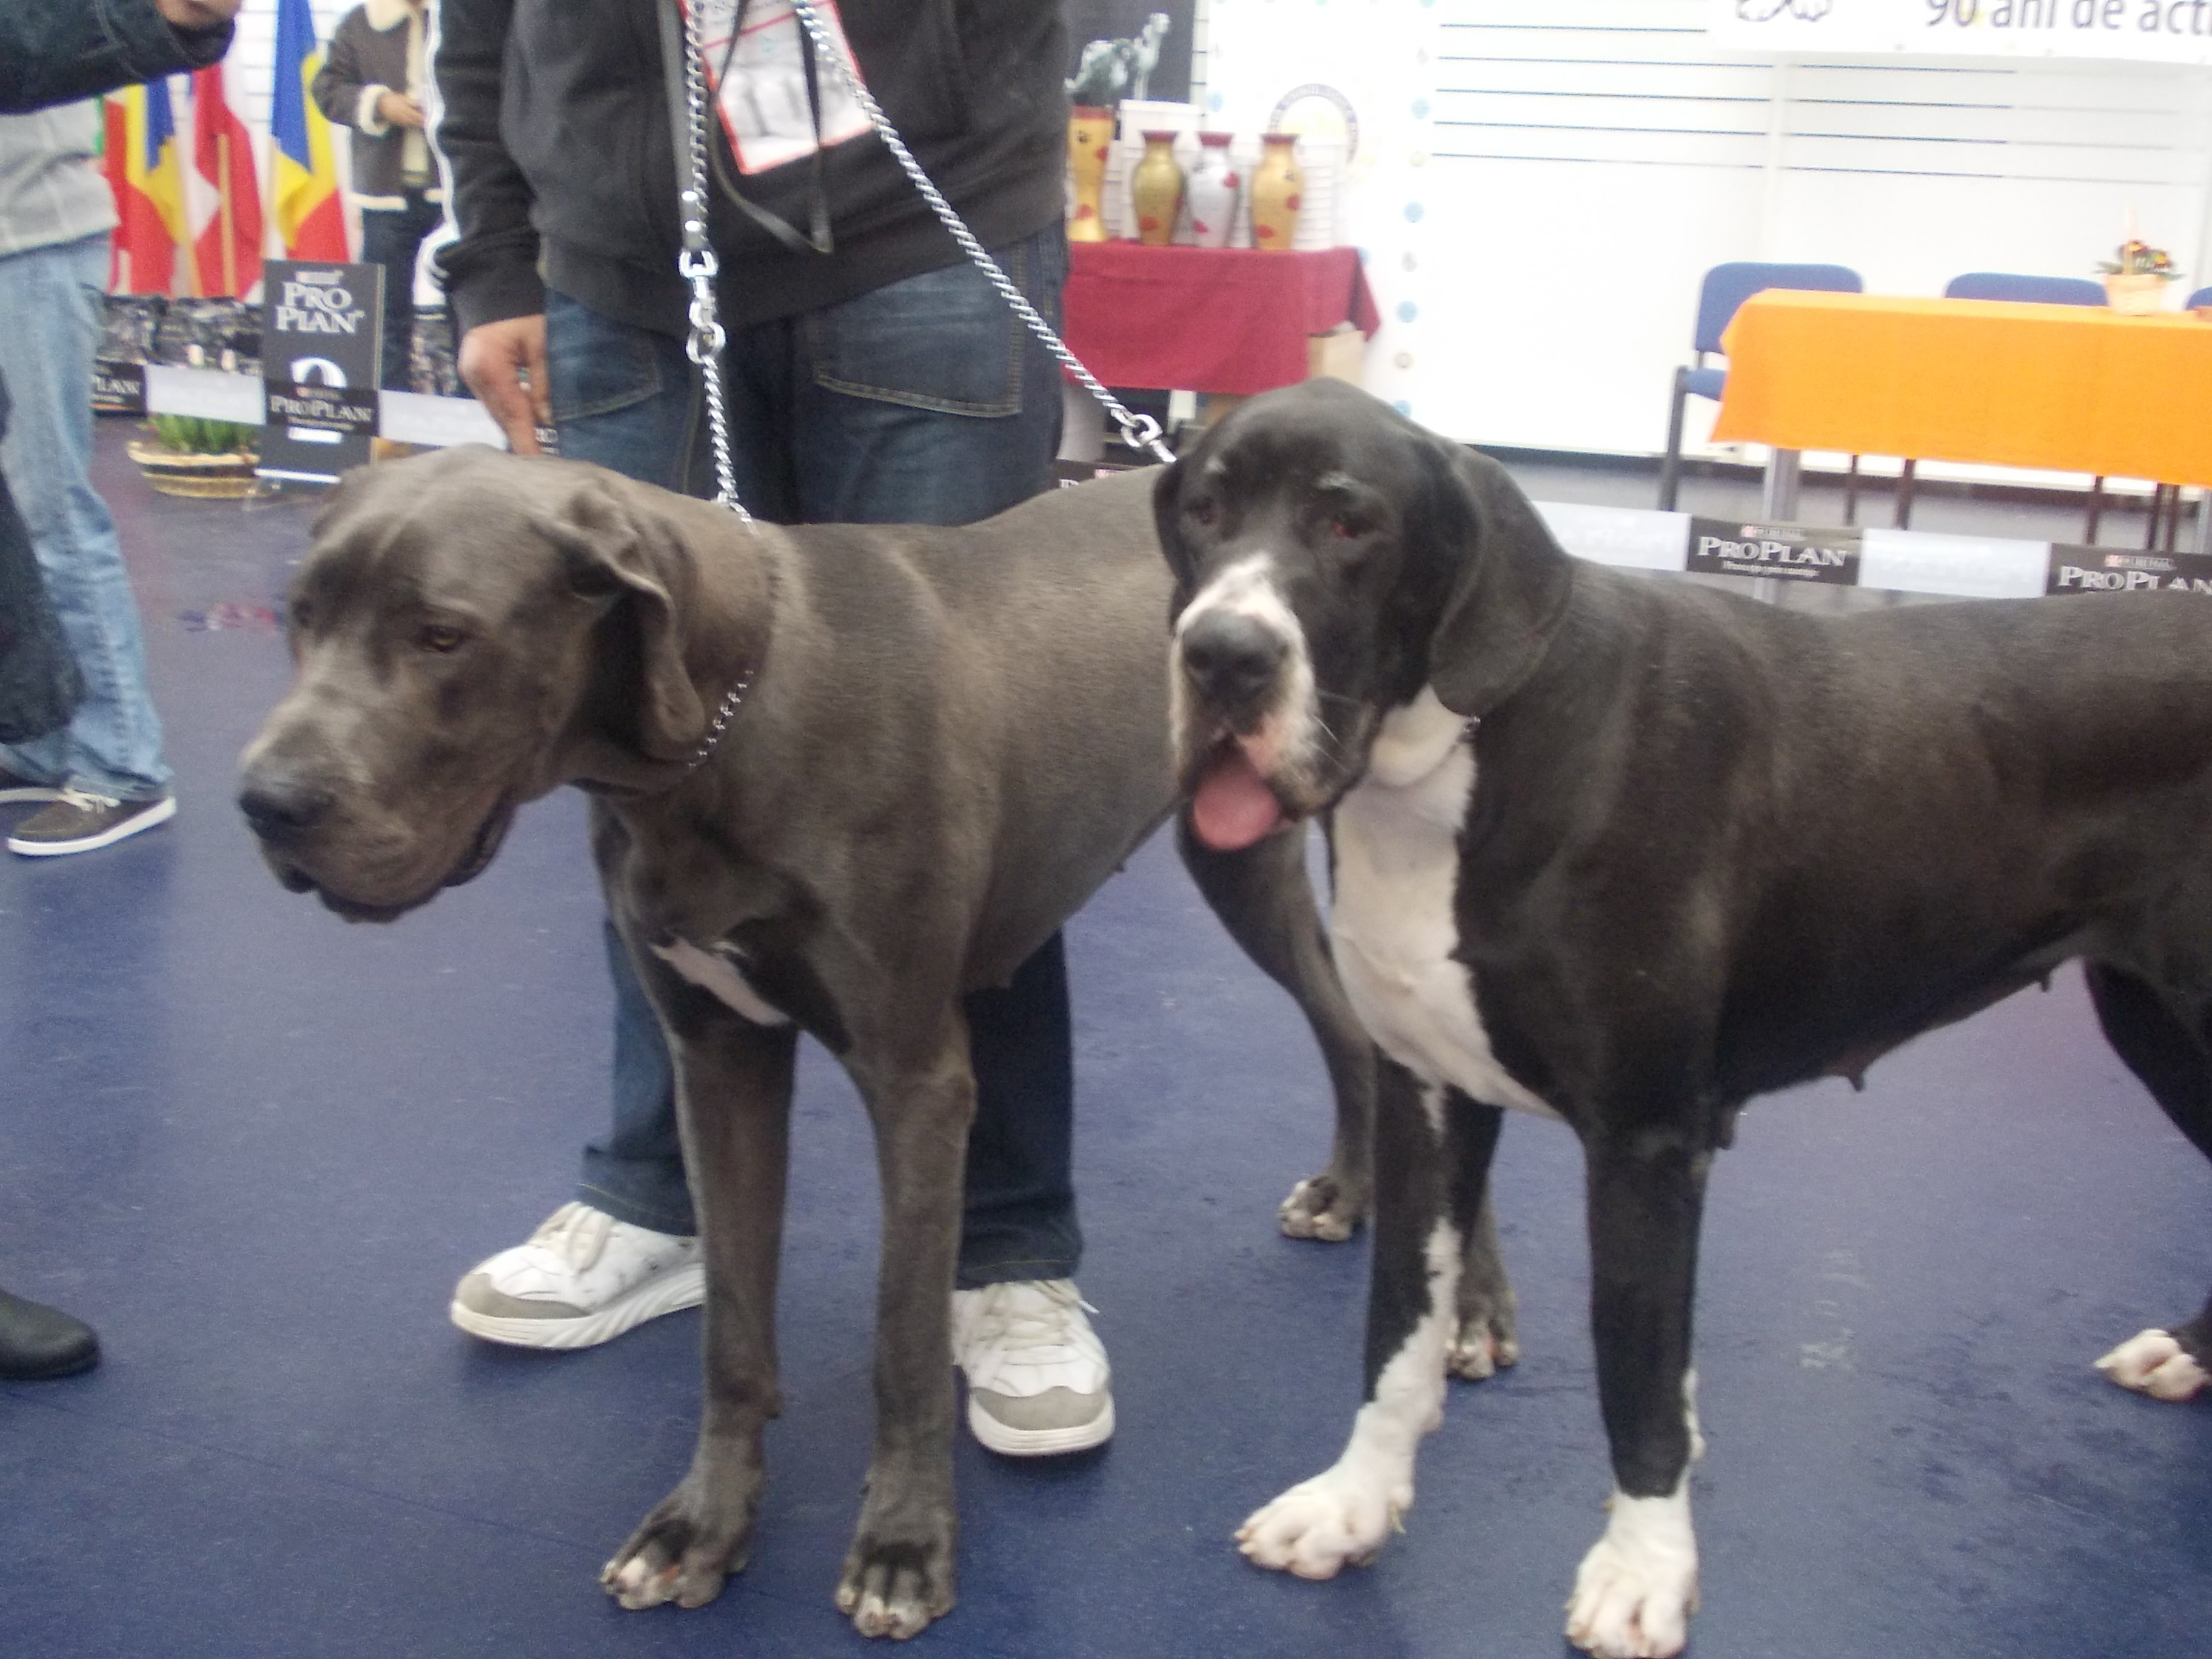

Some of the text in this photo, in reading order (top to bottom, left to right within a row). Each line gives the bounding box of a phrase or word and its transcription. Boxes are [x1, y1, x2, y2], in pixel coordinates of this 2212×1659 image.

[1926, 0, 1979, 27] 90
[1991, 0, 2056, 28] ani
[2073, 0, 2123, 29] de
[283, 281, 353, 309] PRO
[276, 305, 356, 333] PLAN
